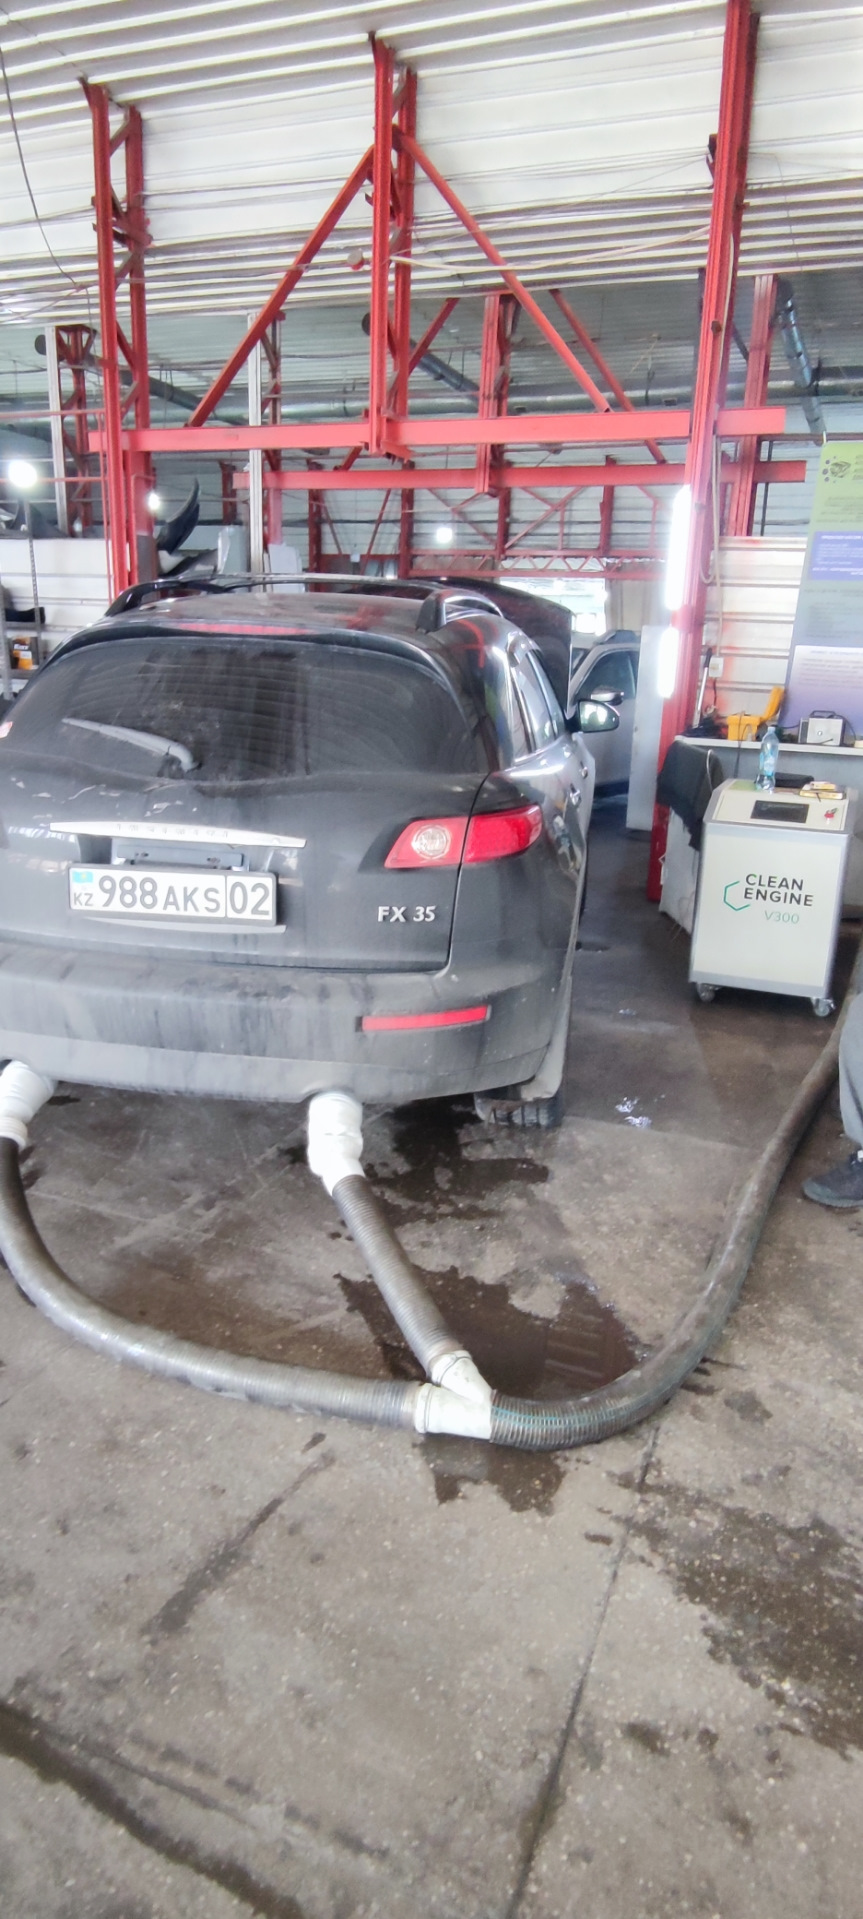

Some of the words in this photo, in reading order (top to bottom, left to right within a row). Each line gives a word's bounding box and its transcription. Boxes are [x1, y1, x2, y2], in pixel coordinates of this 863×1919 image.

[745, 873, 804, 891] CLEAN
[73, 892, 94, 907] KZ
[743, 887, 814, 907] ENGINE
[377, 905, 407, 923] FX
[413, 905, 437, 923] 35
[764, 910, 800, 925] V300
